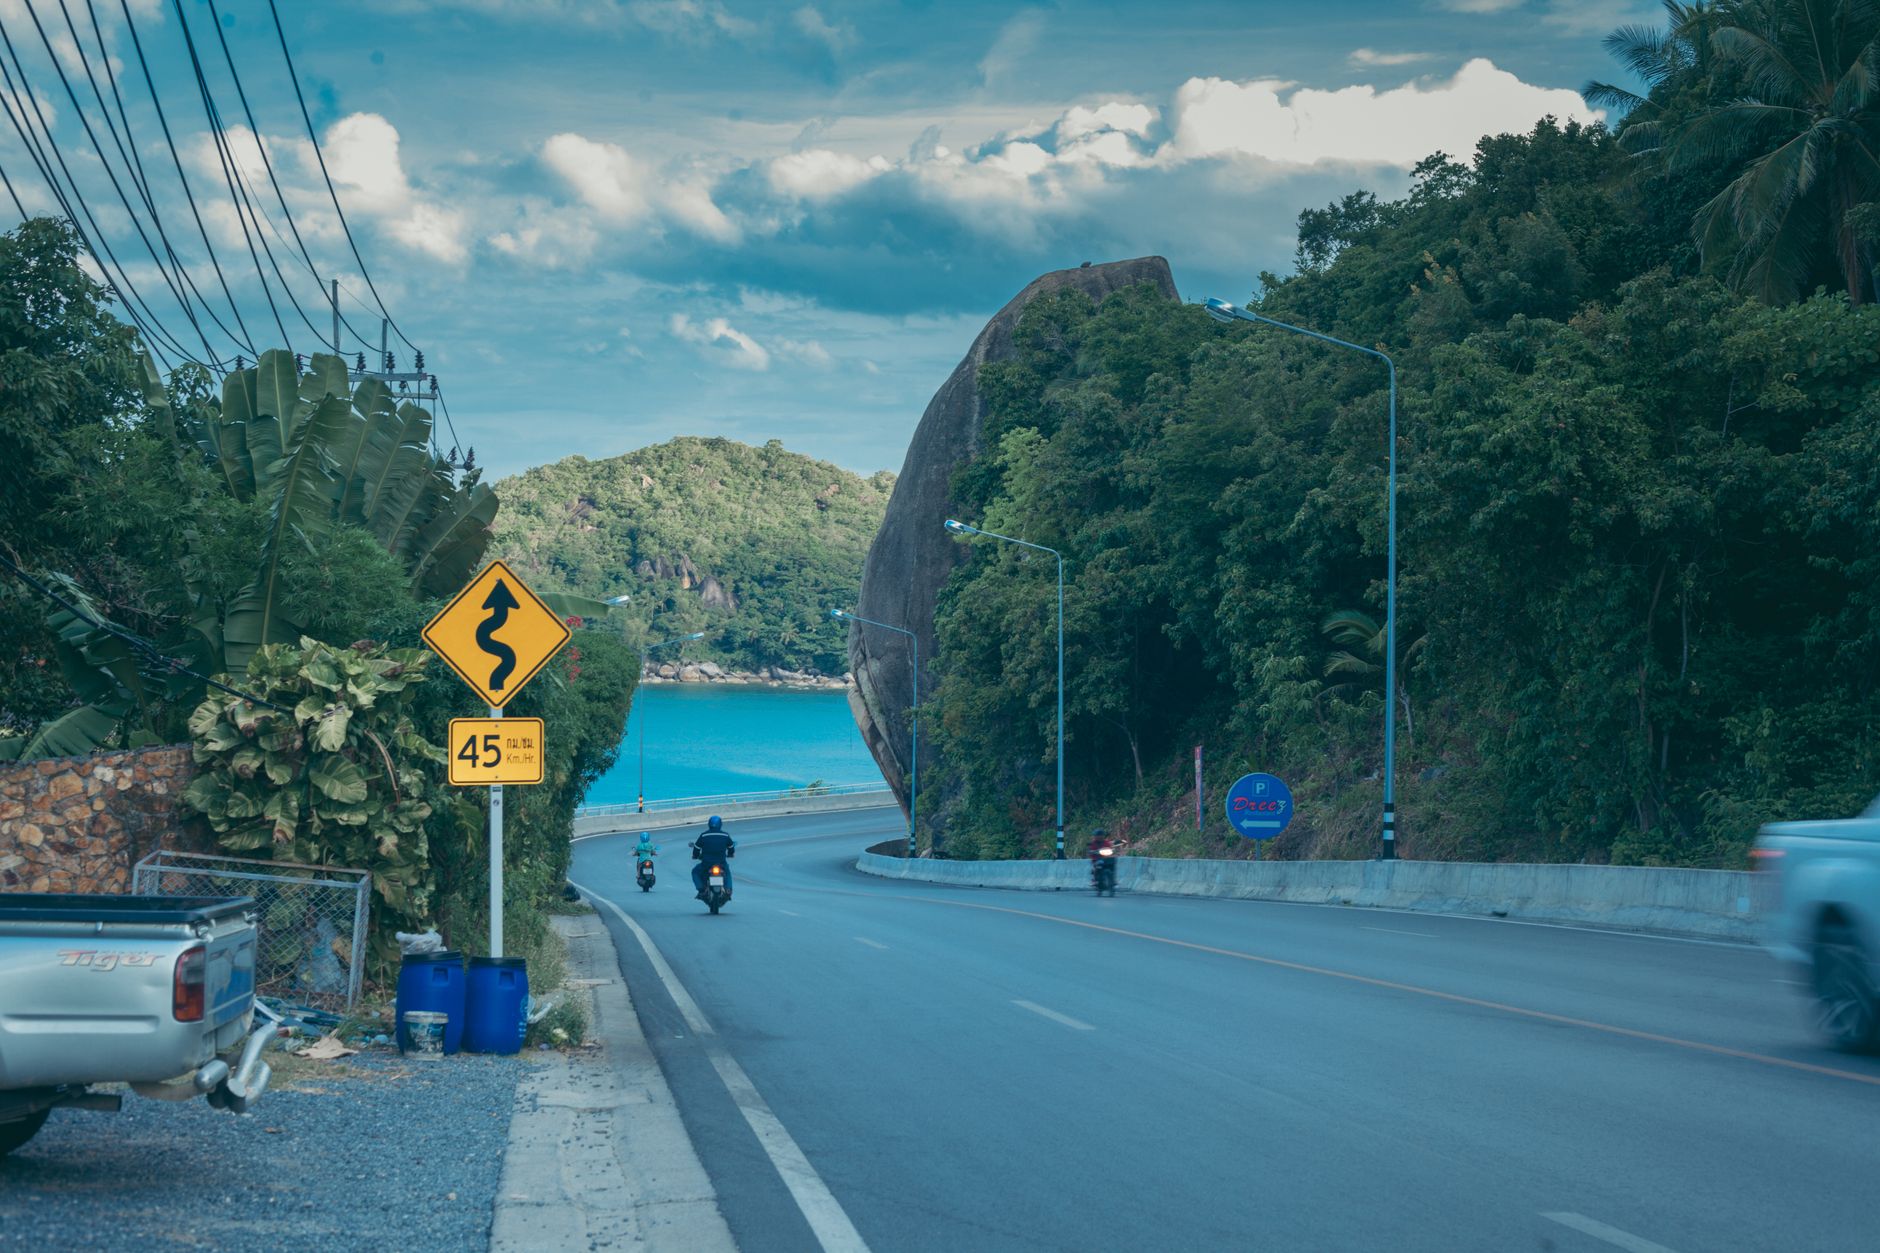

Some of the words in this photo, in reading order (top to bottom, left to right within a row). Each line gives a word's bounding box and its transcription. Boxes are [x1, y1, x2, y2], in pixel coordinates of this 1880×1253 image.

[457, 734, 502, 768] 45
[1255, 782, 1266, 794] P
[56, 949, 166, 972] Tiger
